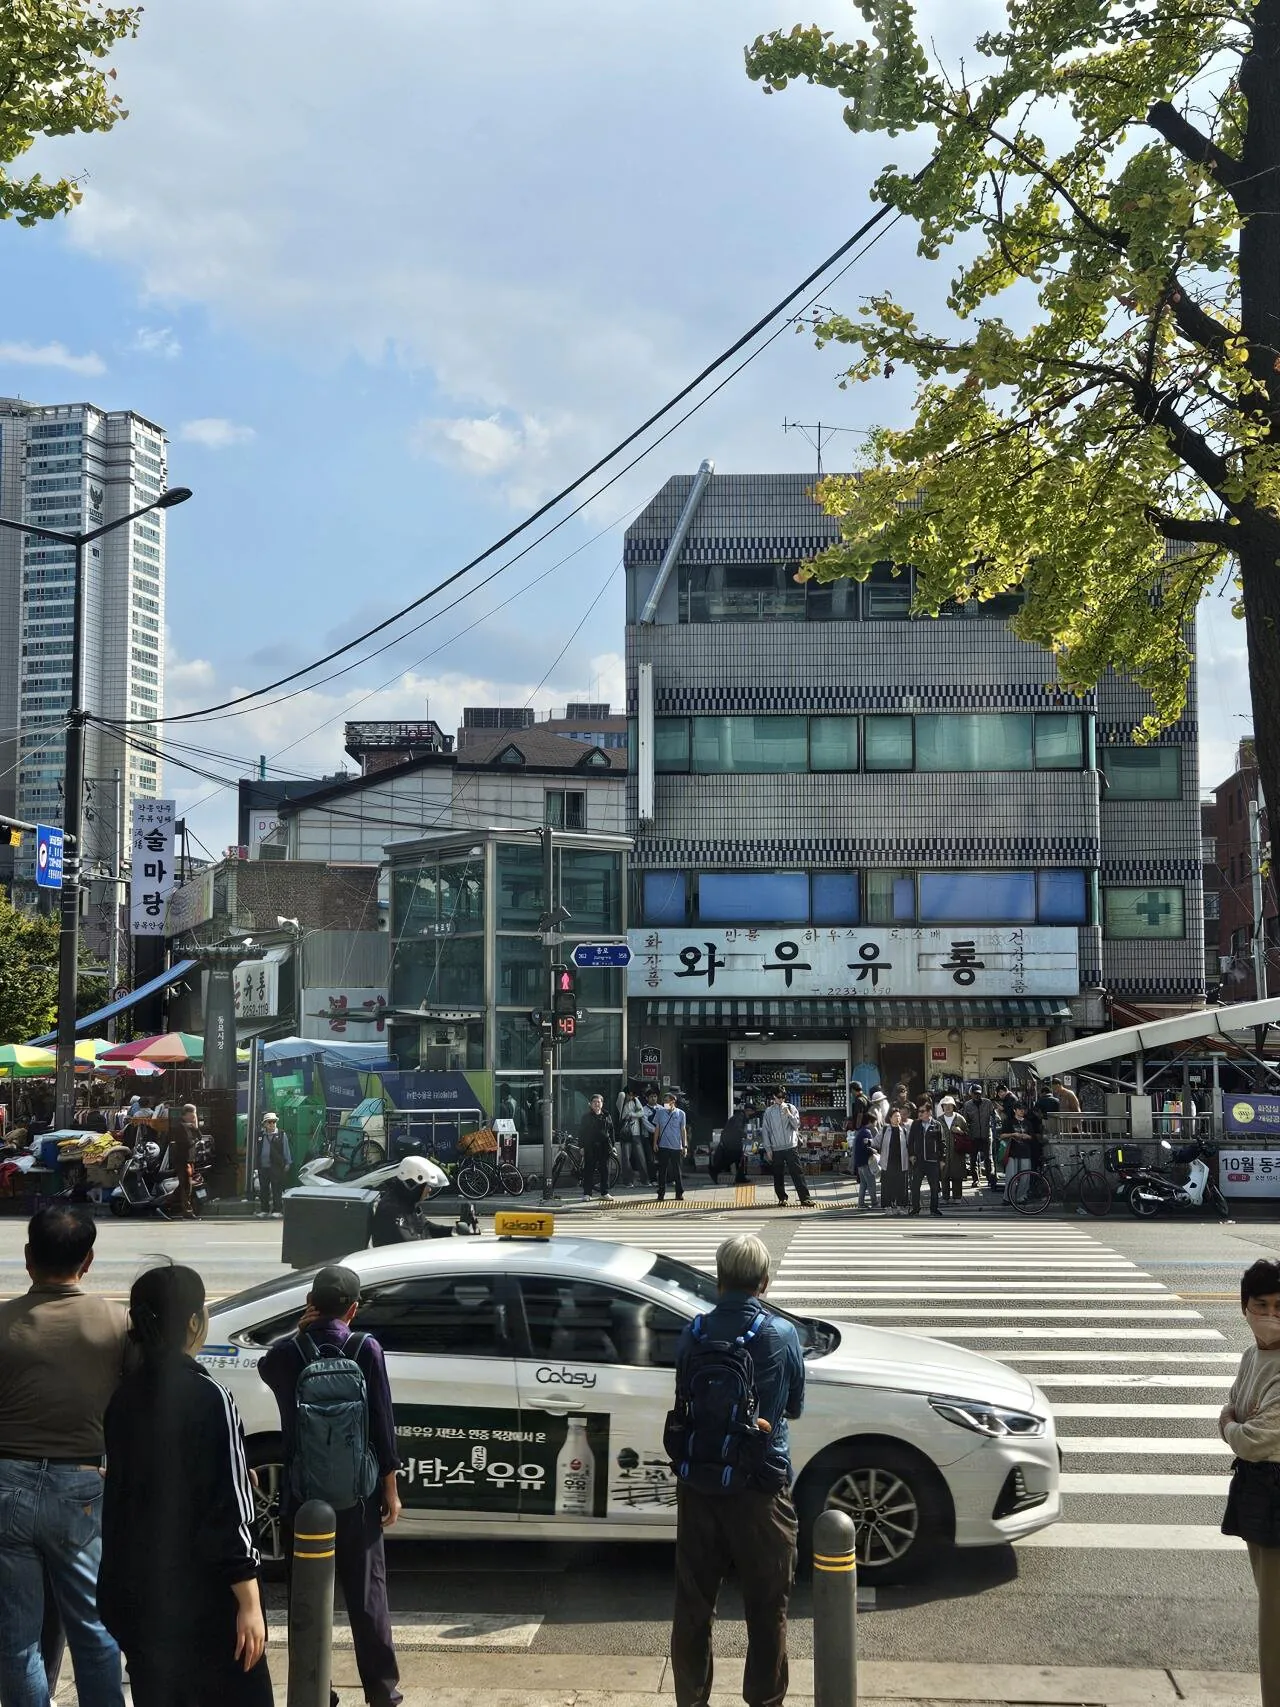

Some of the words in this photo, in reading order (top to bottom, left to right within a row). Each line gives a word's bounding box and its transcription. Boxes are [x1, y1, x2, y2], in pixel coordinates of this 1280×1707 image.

[143, 828, 168, 916] 술마당
[643, 931, 662, 988] 화장품
[673, 940, 985, 988] 와우유통
[559, 1017, 574, 1033] 43
[1222, 1157, 1254, 1173] 10월
[486, 1462, 546, 1490] 우유
